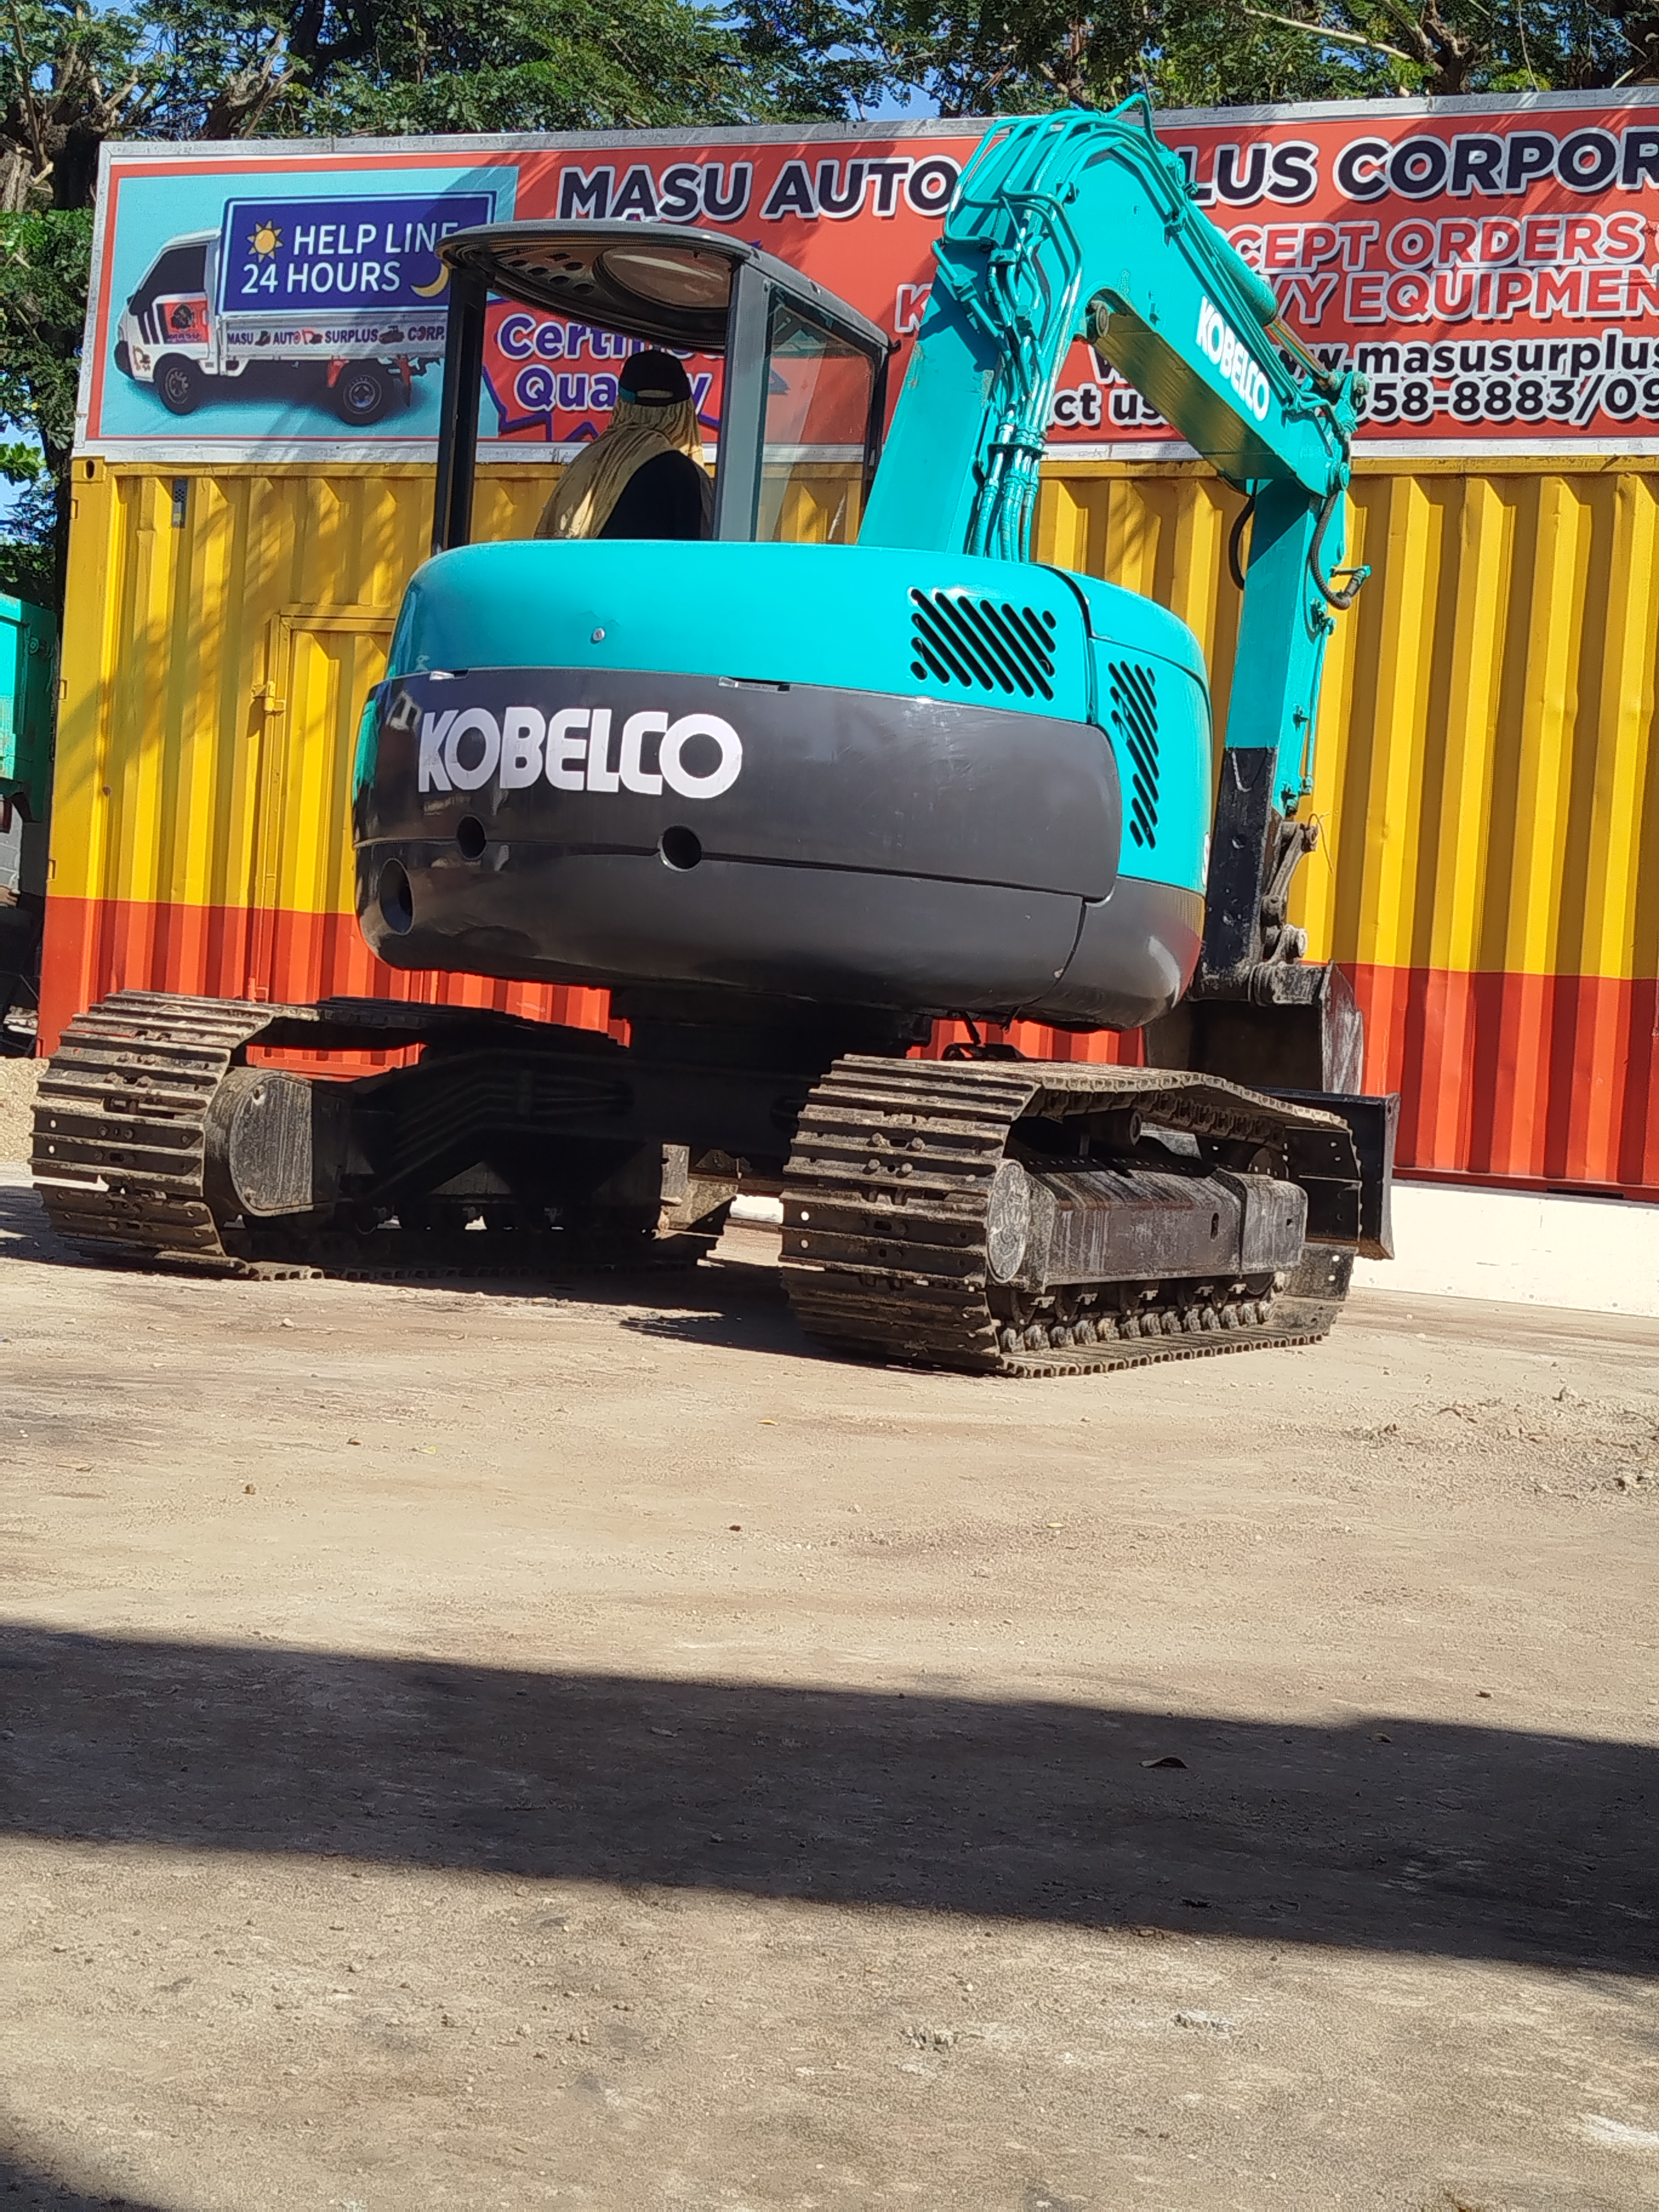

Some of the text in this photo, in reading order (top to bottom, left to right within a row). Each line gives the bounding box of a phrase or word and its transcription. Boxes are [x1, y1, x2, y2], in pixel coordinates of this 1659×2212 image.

[557, 164, 750, 221] MASU
[763, 159, 961, 216] AUTO
[293, 223, 377, 255] HELP
[1227, 213, 1641, 269] CEPT ORDERS
[241, 261, 400, 294] 24 HOURS
[227, 332, 254, 345] MASU
[273, 330, 300, 345] AUTO
[324, 328, 379, 343] SURPLUS
[1196, 295, 1270, 422] KOBELCO
[419, 707, 743, 799] KOBELCO
